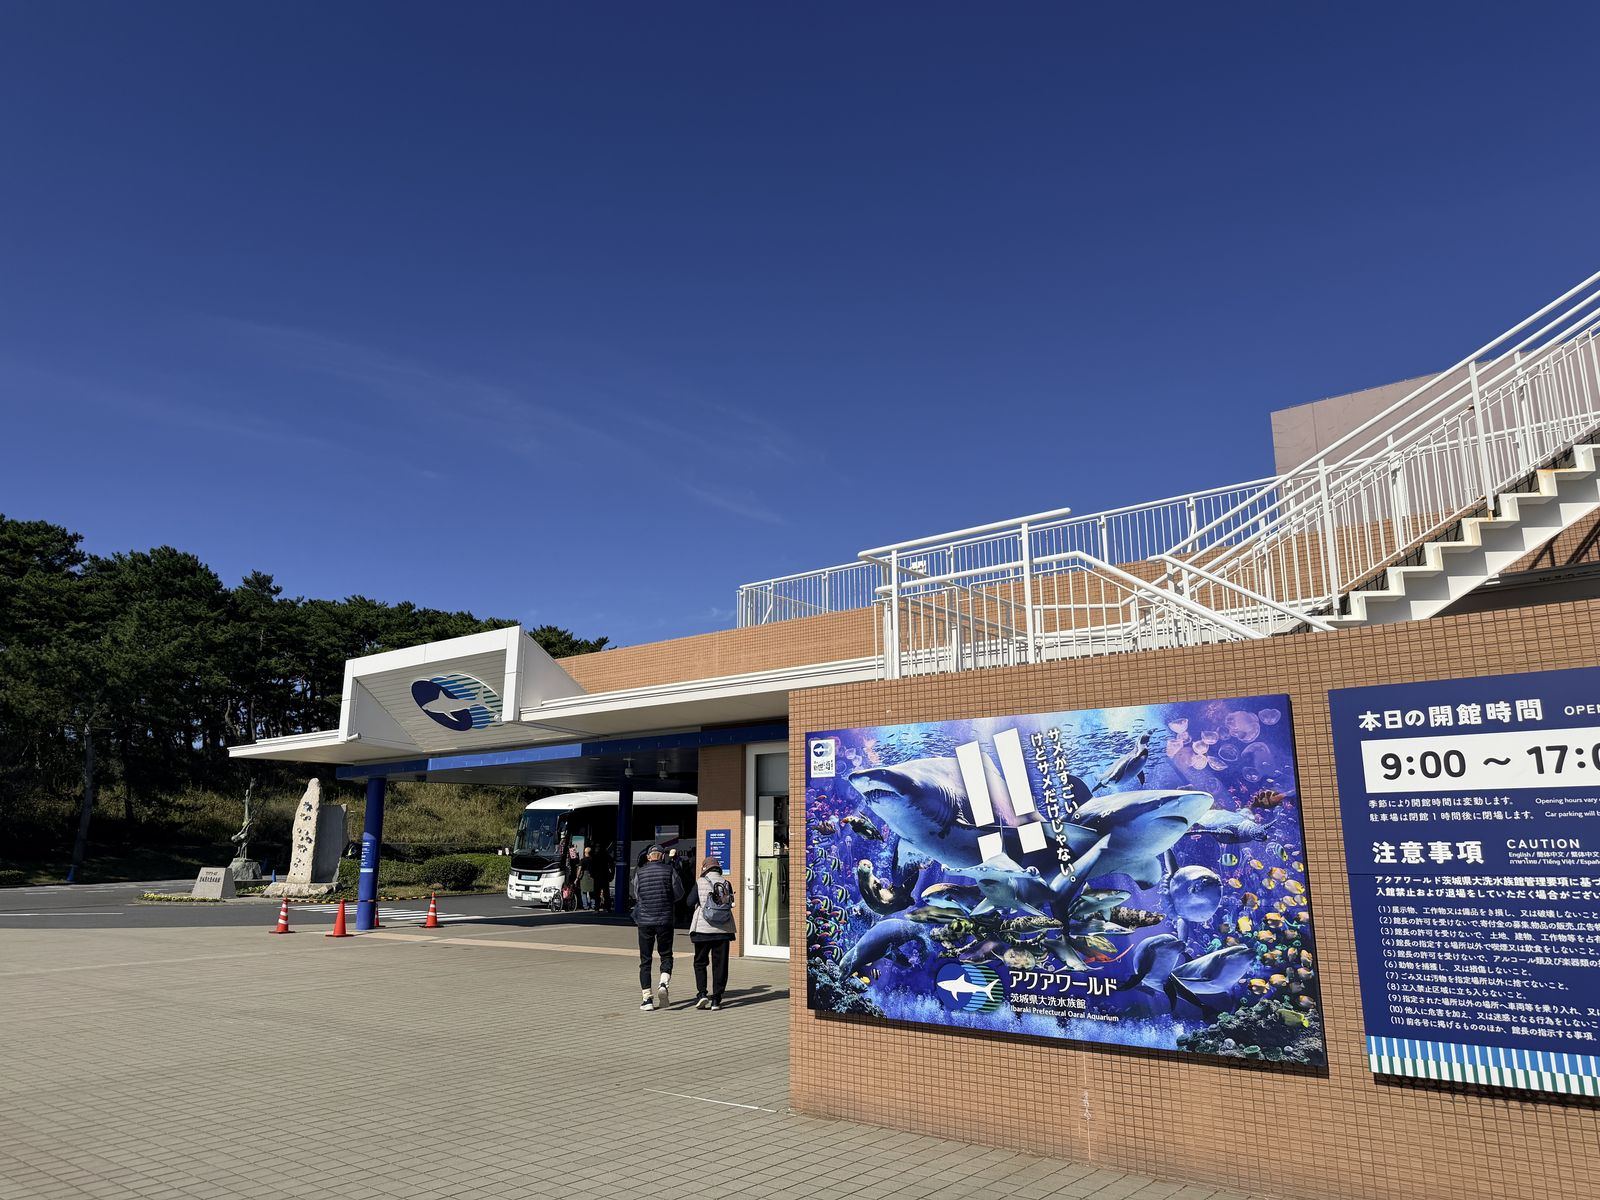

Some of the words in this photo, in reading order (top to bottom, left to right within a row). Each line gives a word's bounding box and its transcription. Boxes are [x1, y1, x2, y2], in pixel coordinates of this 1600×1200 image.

[1358, 698, 1543, 731] 本日の開館時間
[1380, 749, 1466, 781] 9:00
[1048, 728, 1081, 820] サメがすごい。
[1031, 732, 1077, 883] けどサメだけじゃない。
[1368, 796, 1513, 809] 季節により開館時間は変動します。
[1535, 797, 1564, 805] Opening
[1558, 810, 1583, 818] parking
[1372, 840, 1484, 864] 注意事項
[1506, 839, 1580, 849] CAUTION
[1580, 858, 1600, 866] Españ
[1009, 970, 1117, 996] アクアワールド
[1010, 993, 1086, 1009] 茨城県大洗水族館
[1010, 1005, 1031, 1013] Ibaraki
[1033, 1007, 1066, 1017] Prefectural
[1068, 1010, 1085, 1019] Oarai
[1087, 1013, 1119, 1022] Aquarium
